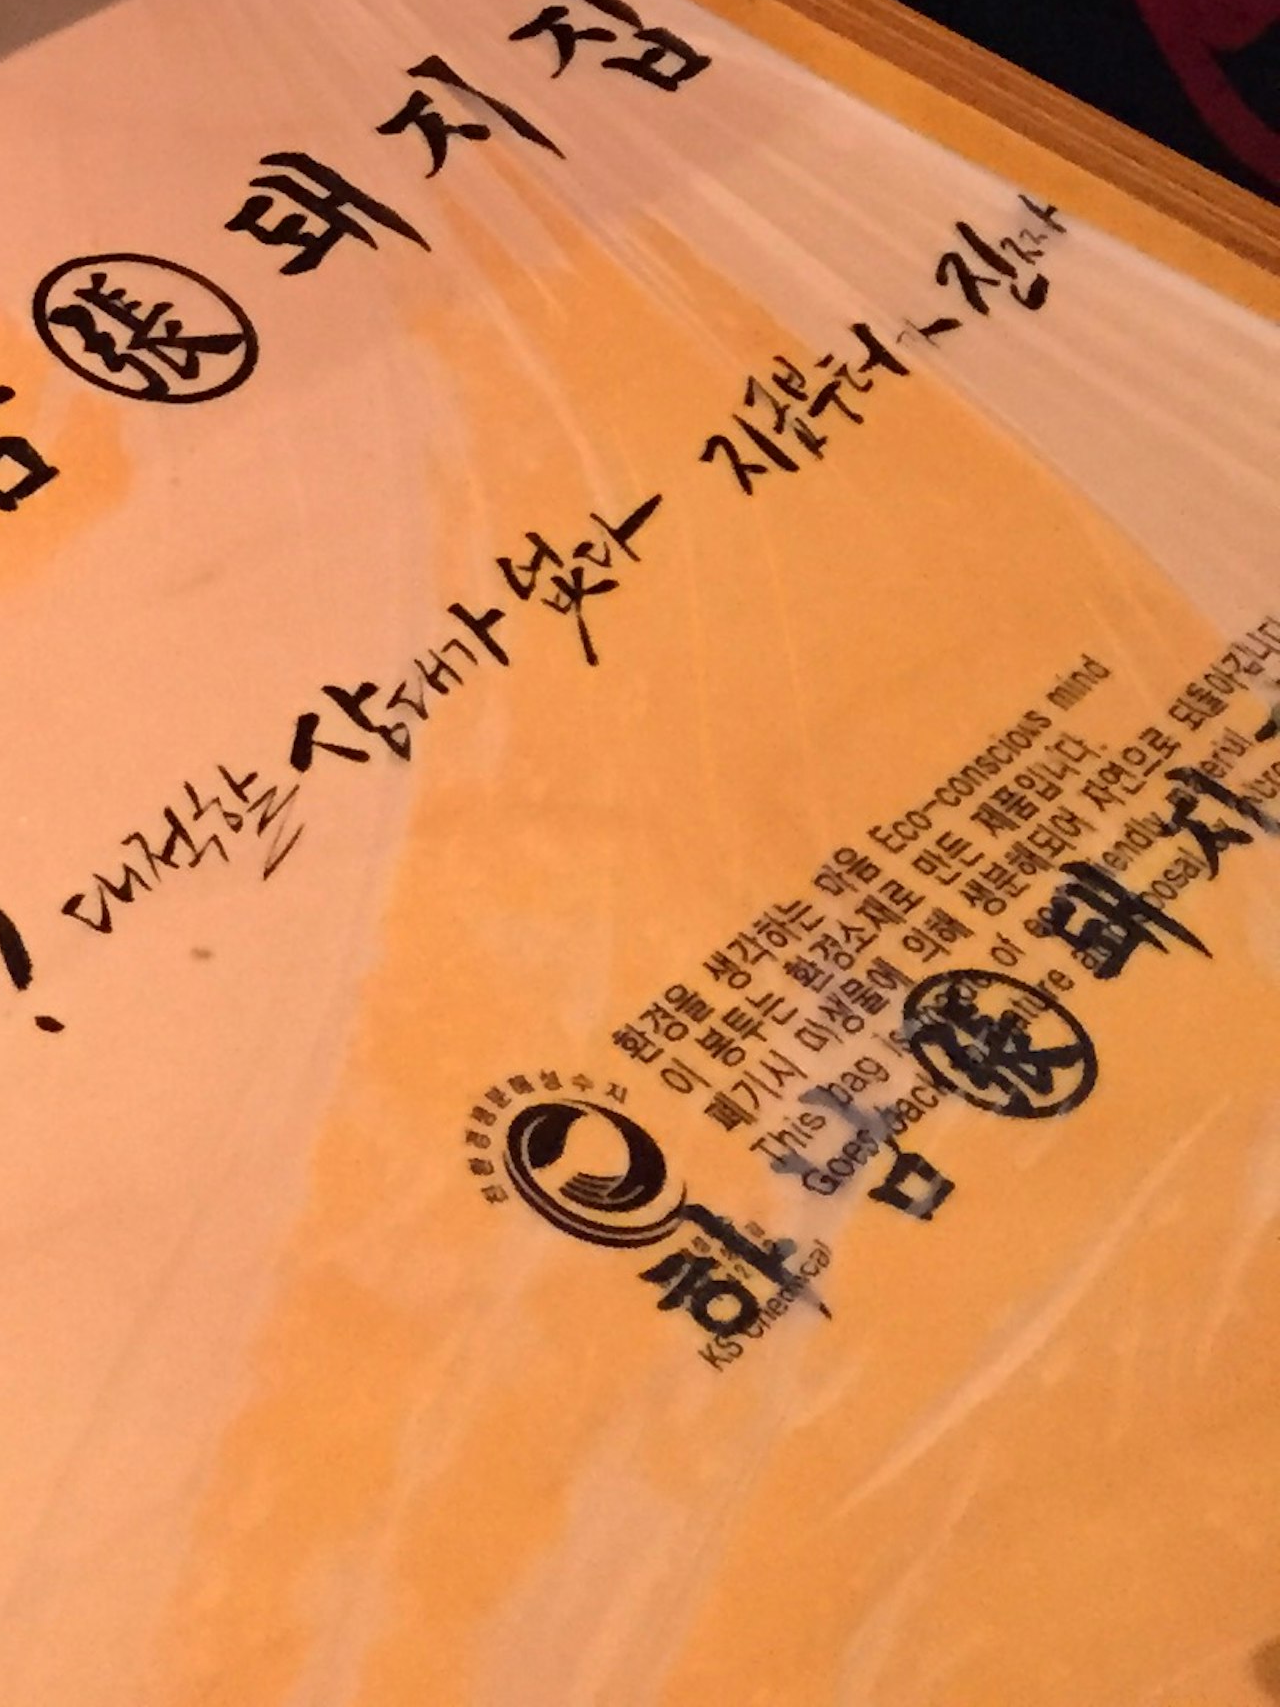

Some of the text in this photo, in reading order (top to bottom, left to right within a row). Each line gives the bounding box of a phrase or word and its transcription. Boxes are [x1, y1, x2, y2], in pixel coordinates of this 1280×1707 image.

[611, 983, 716, 1065] 환경을
[701, 899, 827, 990] 생각하는
[812, 845, 882, 897] 마음
[1045, 652, 1112, 712] mind
[659, 1056, 713, 1095] 이
[693, 990, 799, 1068] 봉투는
[782, 878, 927, 994] 환경소재로
[910, 829, 986, 887] 만든
[703, 1047, 809, 1132] 폐기시
[793, 955, 918, 1053] 미생물에
[901, 905, 976, 964] 의해
[957, 804, 1098, 918] 생분해되어
[1079, 725, 1184, 813] 자연으로
[748, 1109, 827, 1167] This
[989, 930, 1027, 967] of
[800, 1127, 880, 1197] Goes
[696, 1335, 744, 1374] KS
